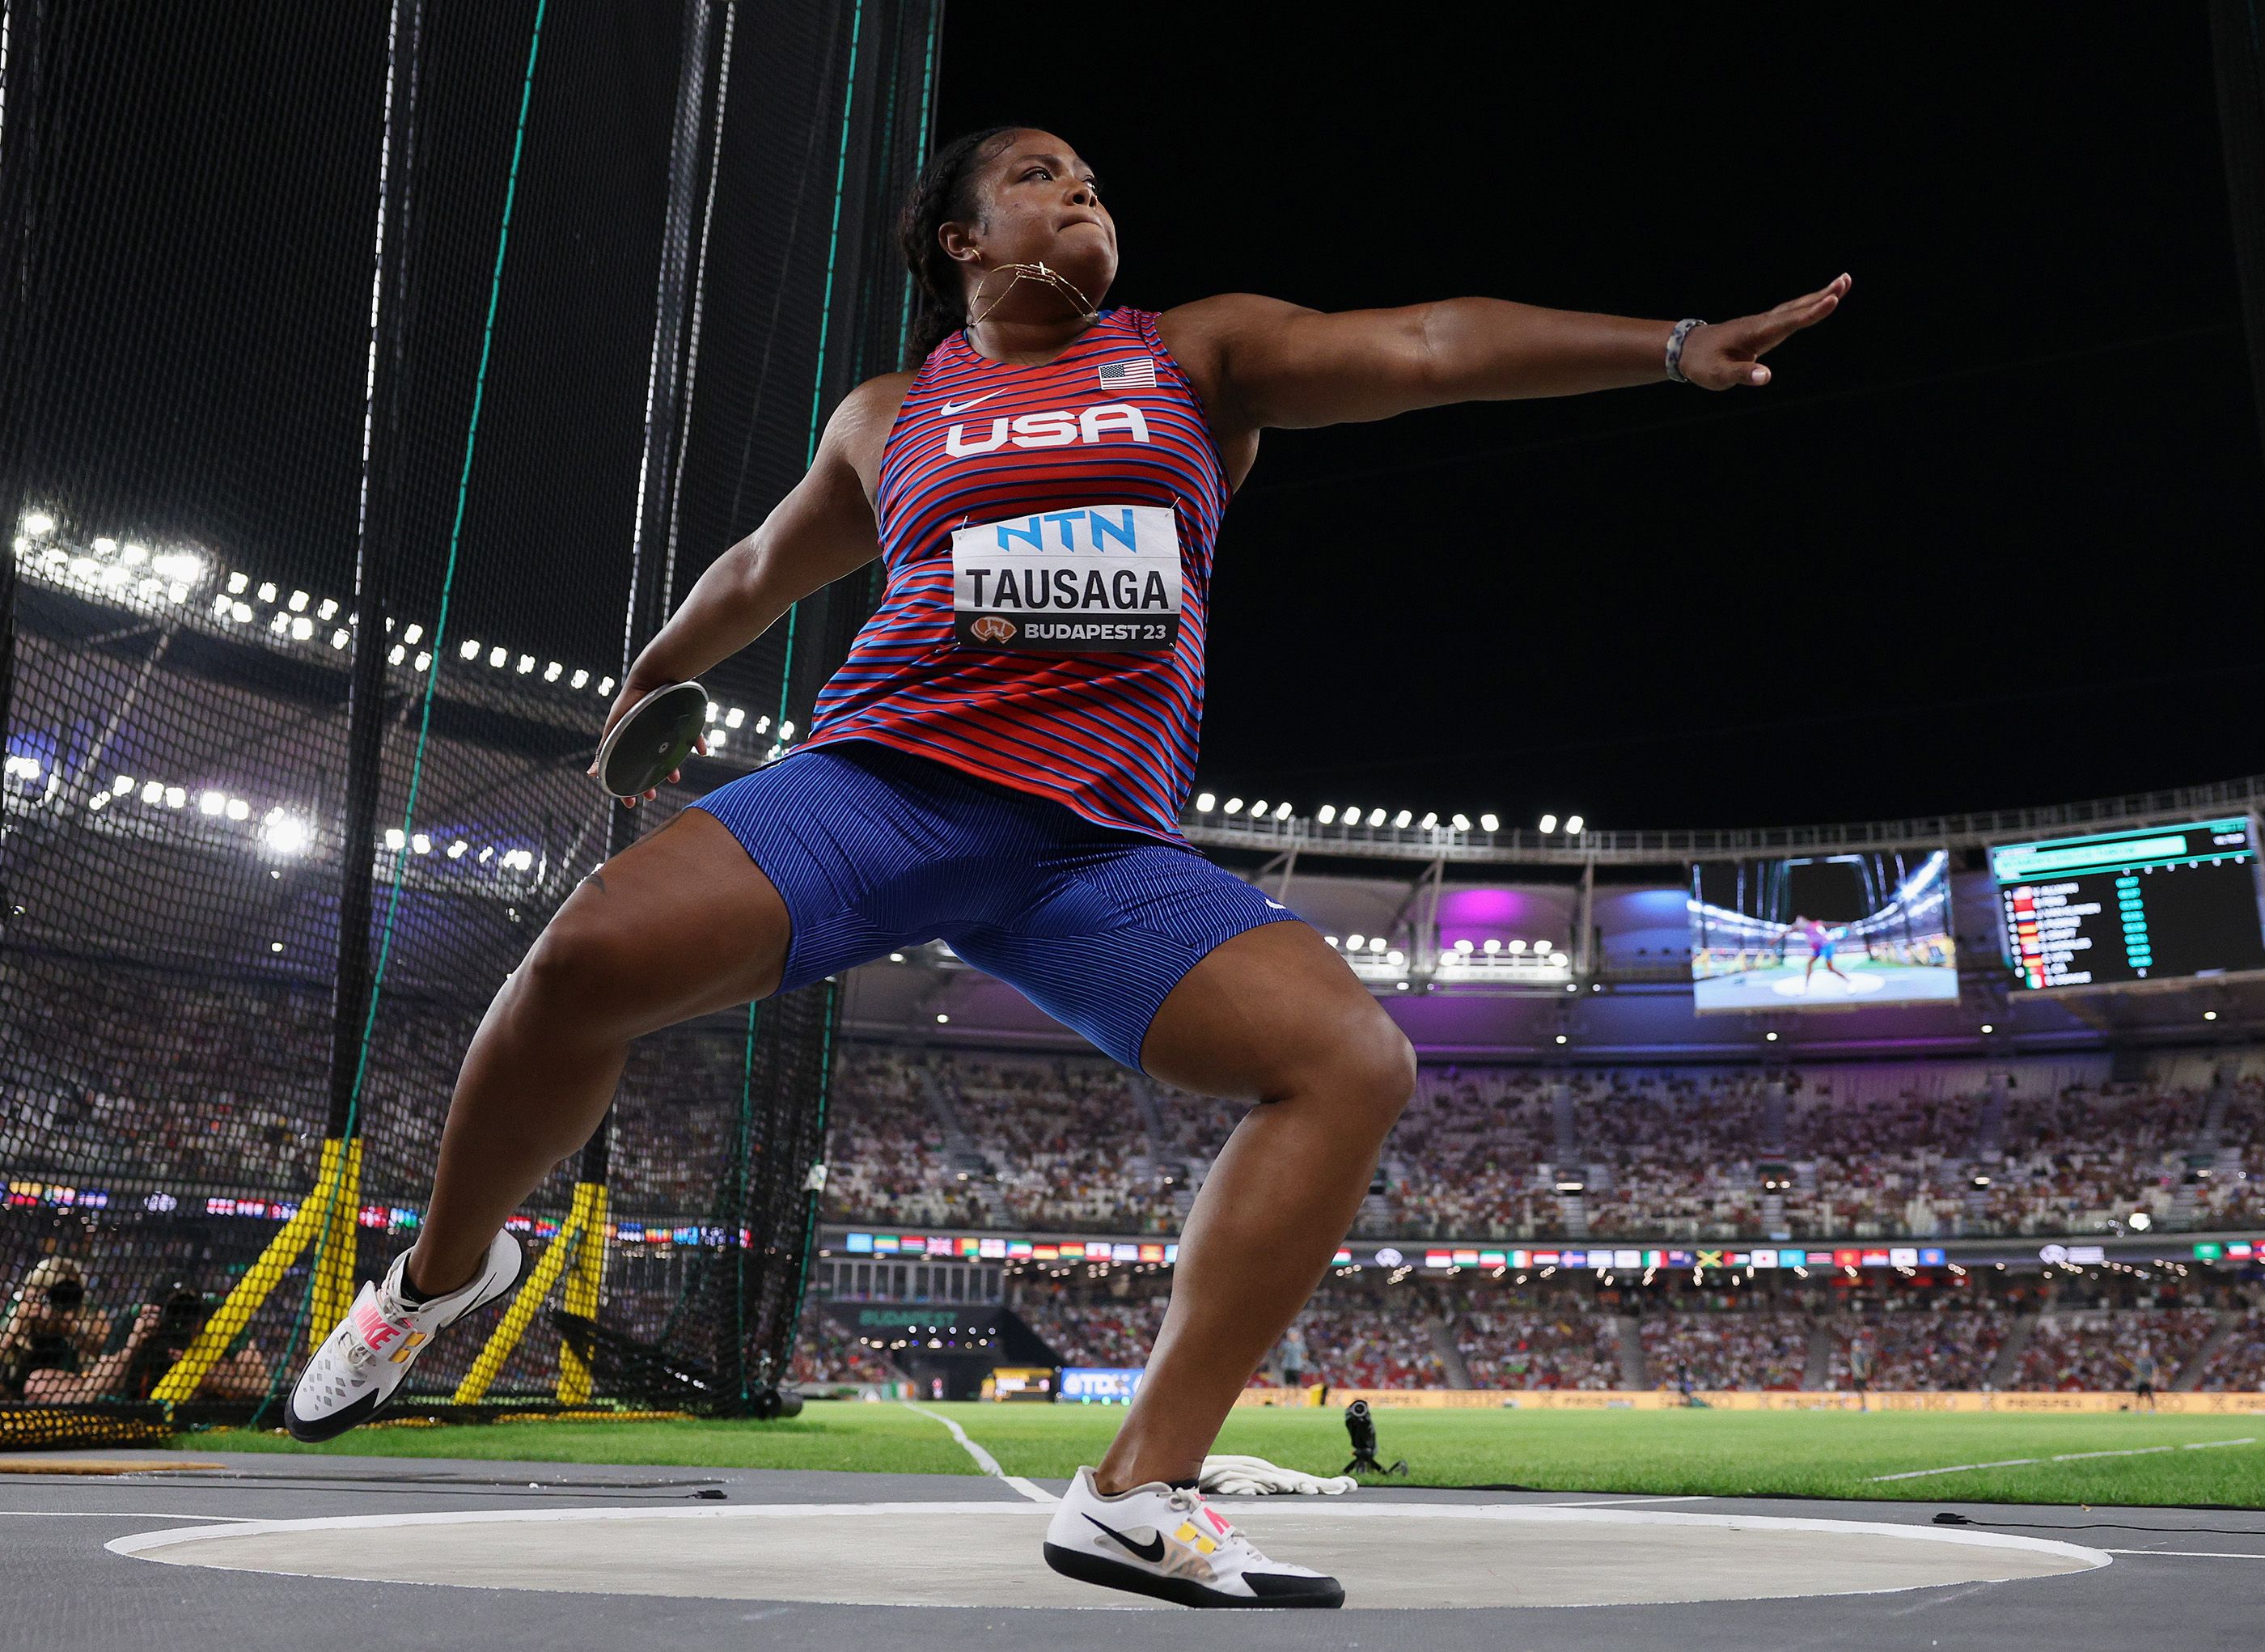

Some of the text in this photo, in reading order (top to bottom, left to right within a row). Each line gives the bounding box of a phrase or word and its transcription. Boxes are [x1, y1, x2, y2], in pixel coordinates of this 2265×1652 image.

[945, 403, 1150, 459] USA
[996, 508, 1137, 553] NTN
[965, 569, 1170, 610] TAUSAGA
[1024, 622, 1166, 641] BUDAPEST 23
[352, 1302, 401, 1351] NIKE
